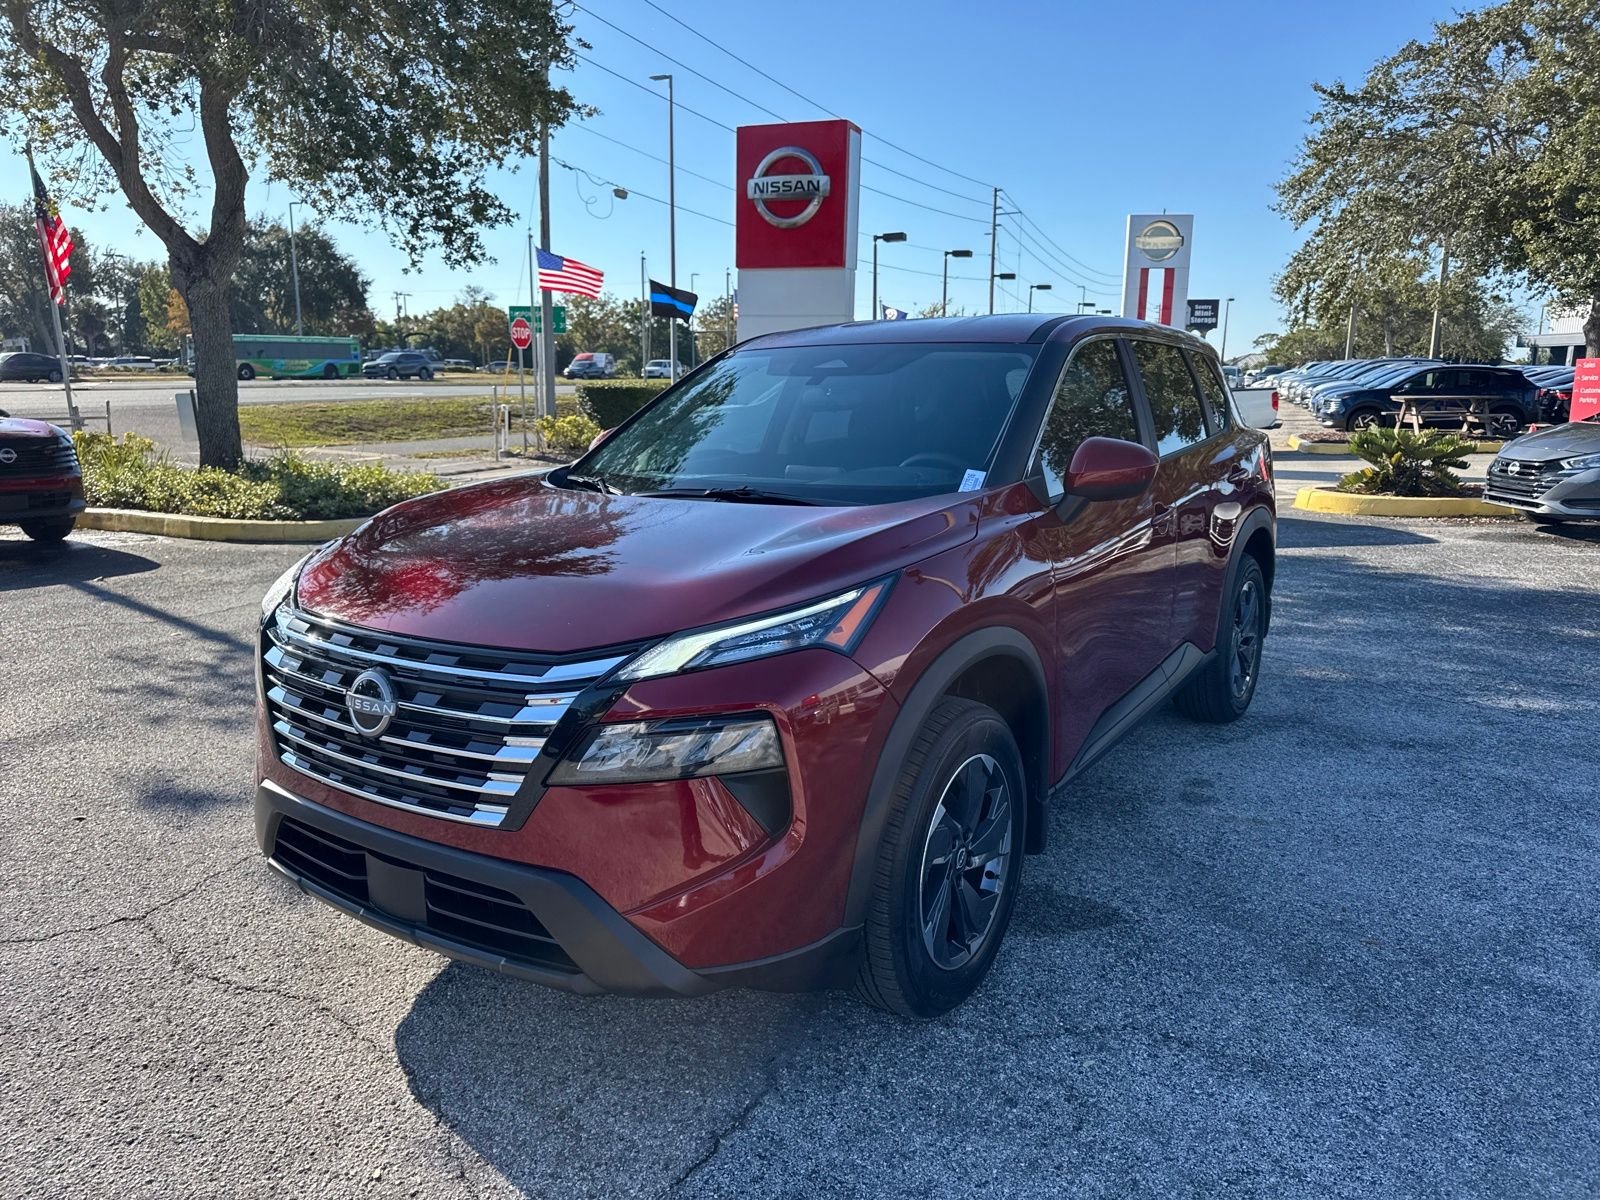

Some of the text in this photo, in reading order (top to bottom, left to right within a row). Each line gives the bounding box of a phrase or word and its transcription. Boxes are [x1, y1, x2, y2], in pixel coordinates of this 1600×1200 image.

[753, 180, 820, 194] NISSAN
[512, 327, 530, 339] STOP
[1579, 397, 1598, 405] Parking
[346, 697, 393, 714] NISSAN
